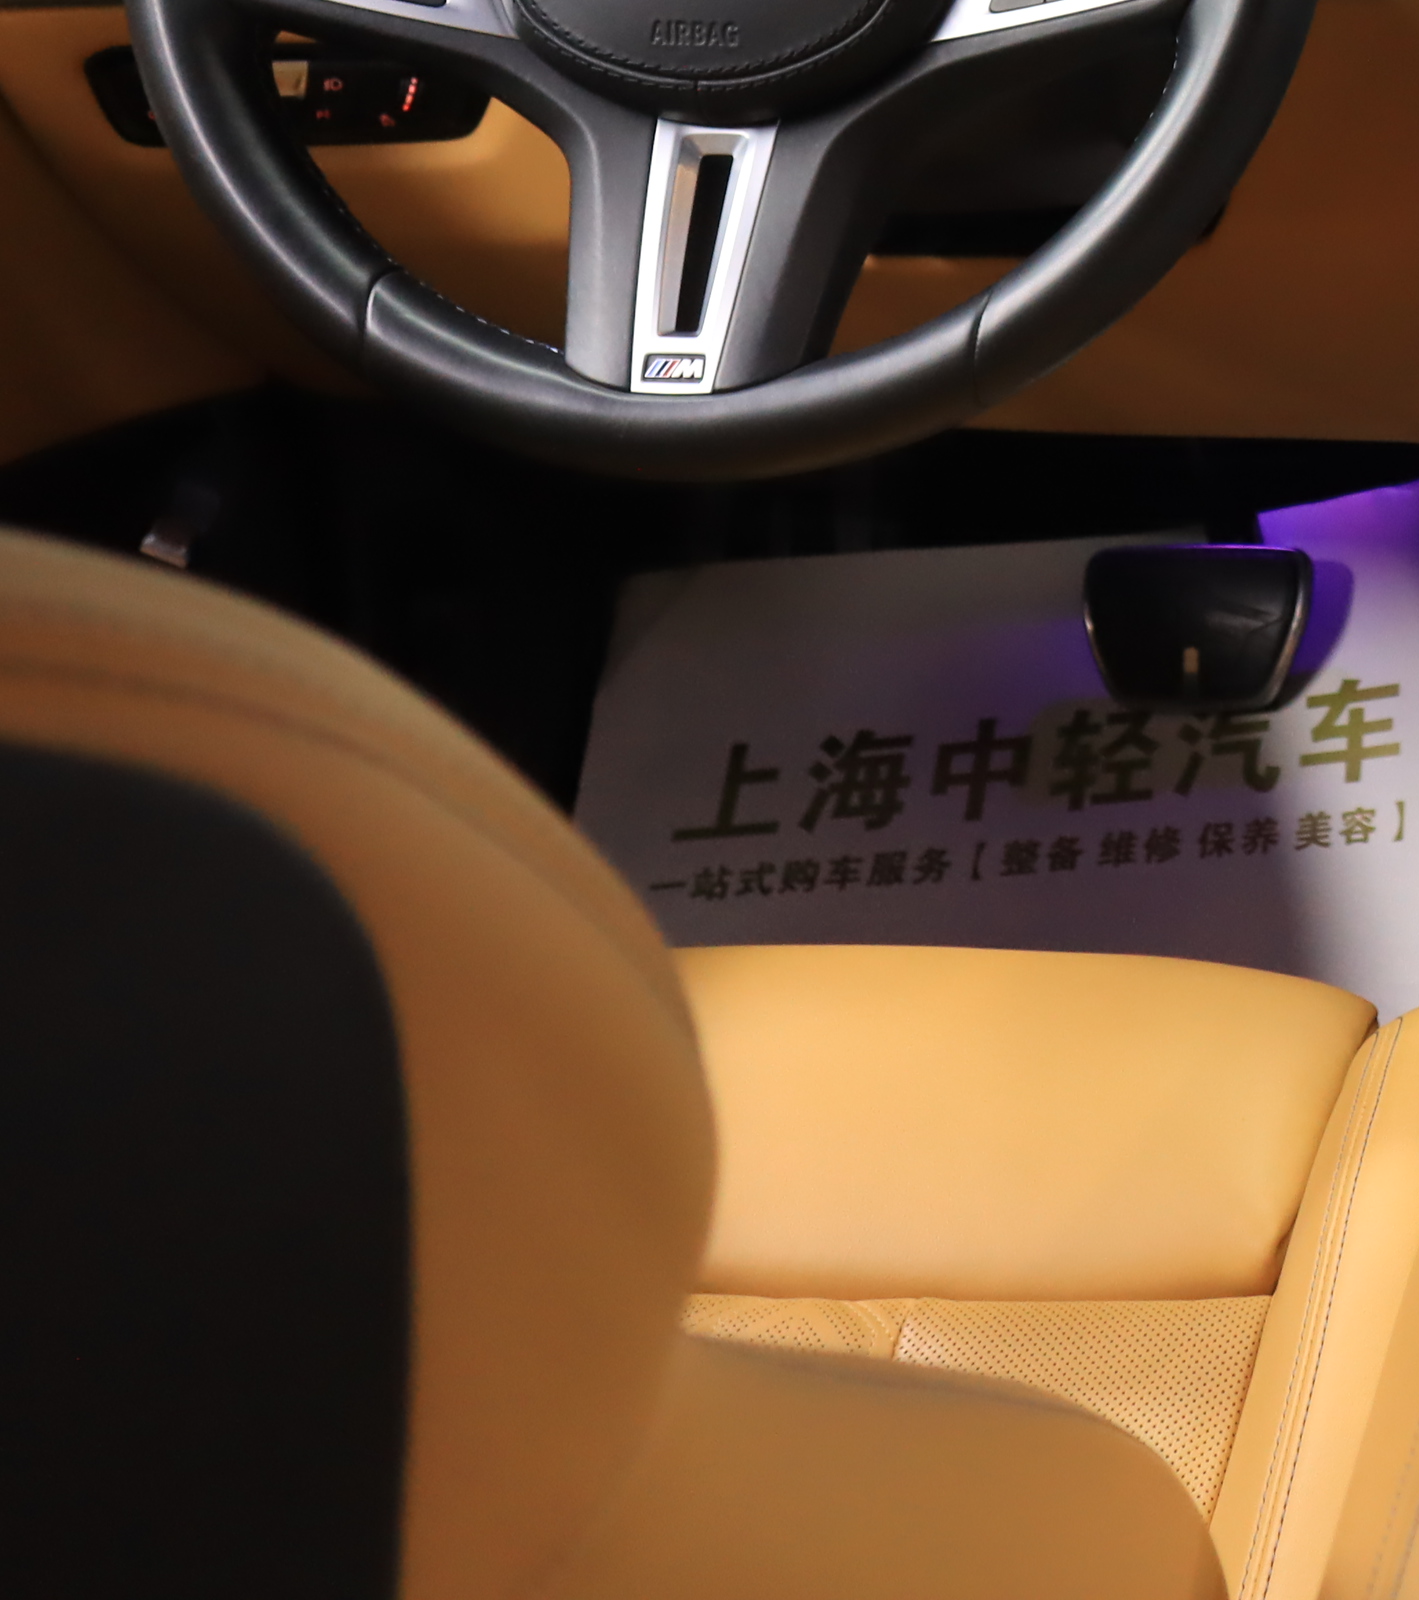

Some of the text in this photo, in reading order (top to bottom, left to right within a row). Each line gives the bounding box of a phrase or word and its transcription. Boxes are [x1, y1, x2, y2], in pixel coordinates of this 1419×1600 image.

[650, 19, 739, 48] AIRBAG
[671, 678, 1401, 843] 上海中轻汽车
[1197, 816, 1280, 859] 保养
